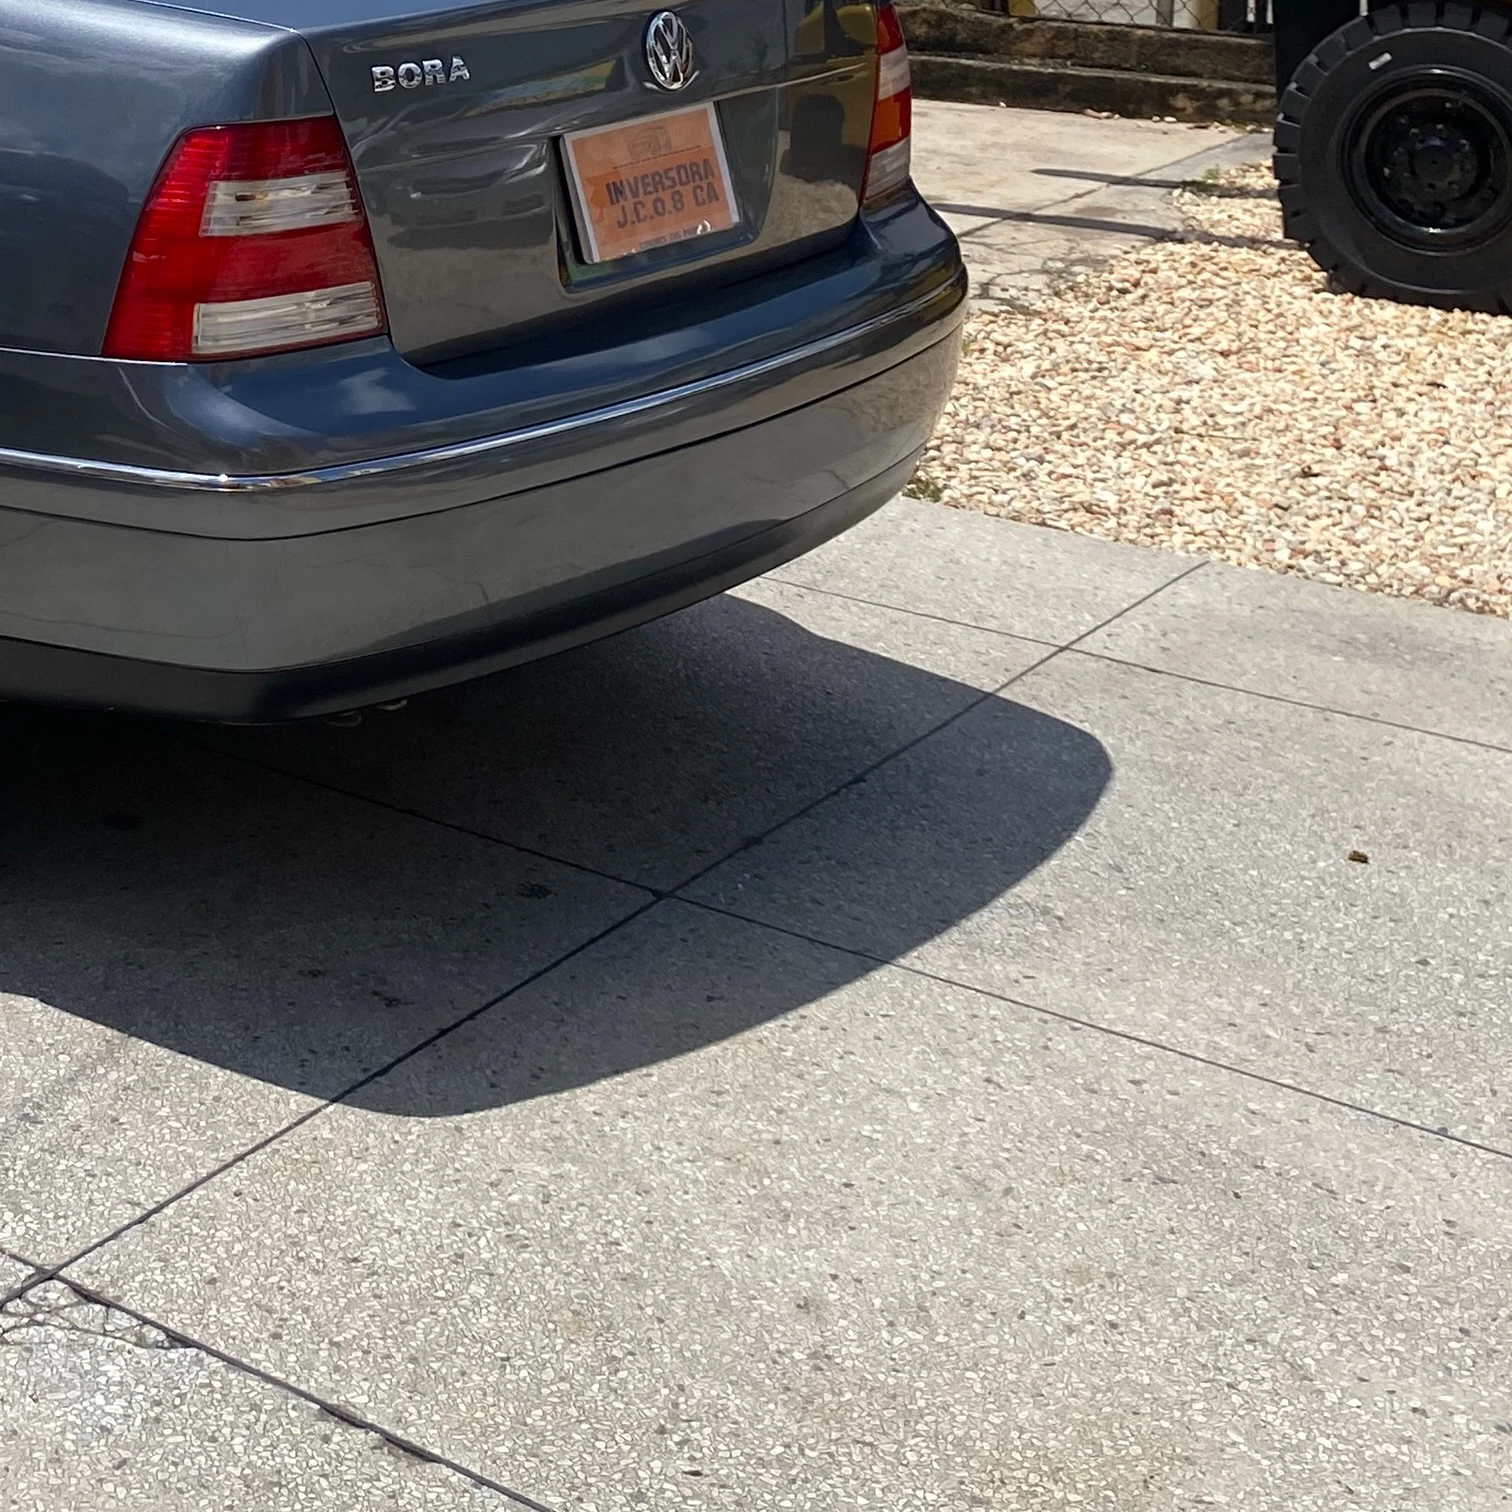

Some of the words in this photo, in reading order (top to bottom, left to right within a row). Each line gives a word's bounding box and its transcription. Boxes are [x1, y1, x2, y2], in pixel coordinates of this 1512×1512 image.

[371, 55, 471, 93] BORA
[605, 158, 716, 206] INVERSORA
[692, 182, 720, 208] CA
